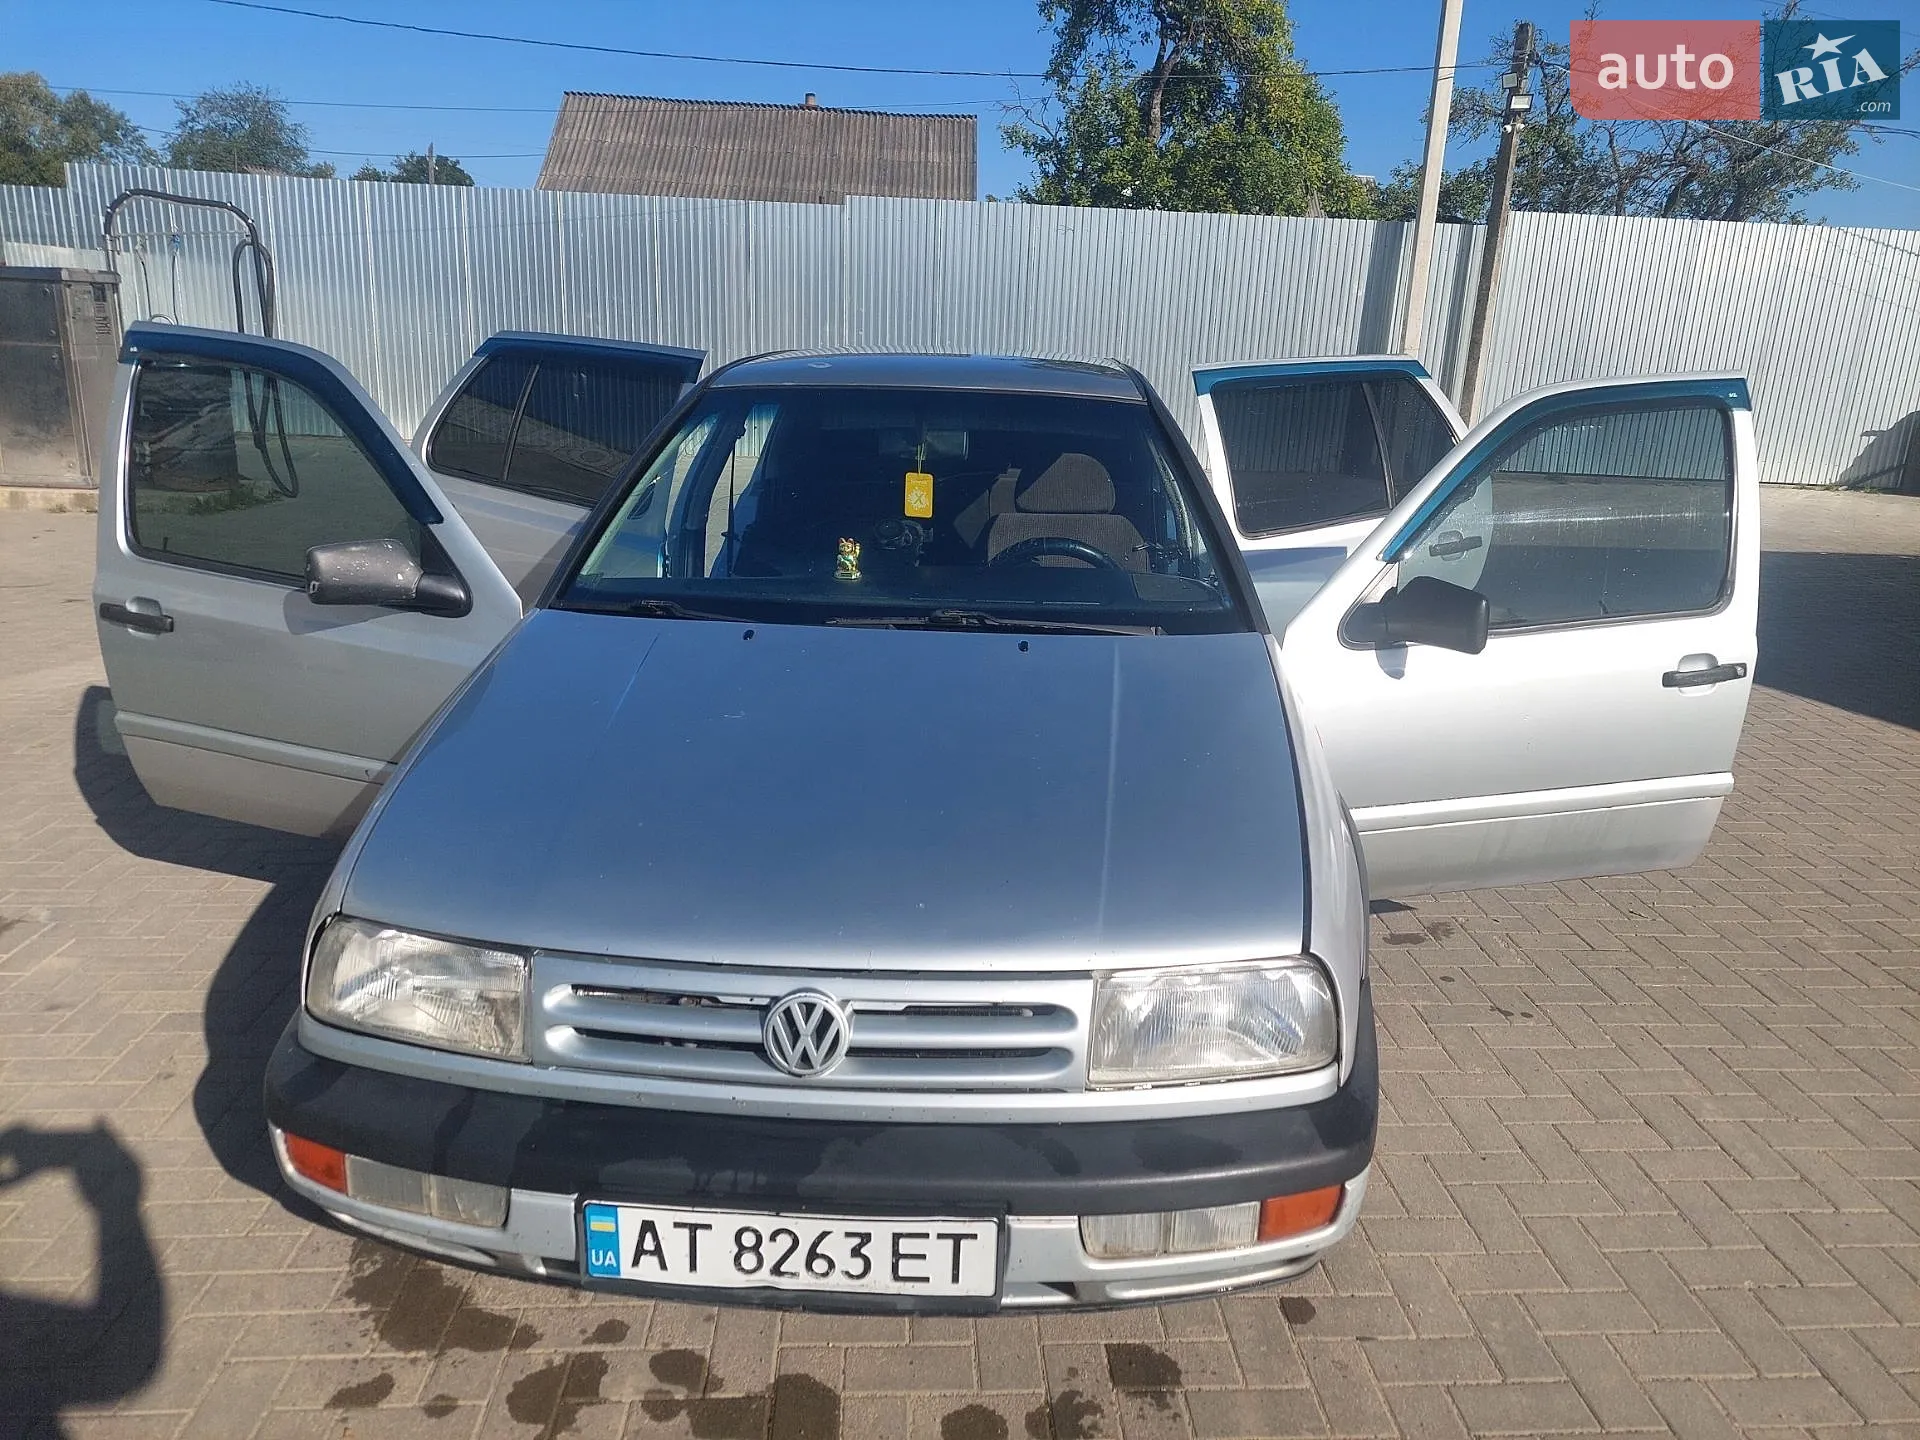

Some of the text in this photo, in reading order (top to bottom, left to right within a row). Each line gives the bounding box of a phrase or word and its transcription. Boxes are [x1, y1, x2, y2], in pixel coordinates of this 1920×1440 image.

[591, 1249, 617, 1267] UA
[631, 1219, 978, 1284] AT 8263 ET
